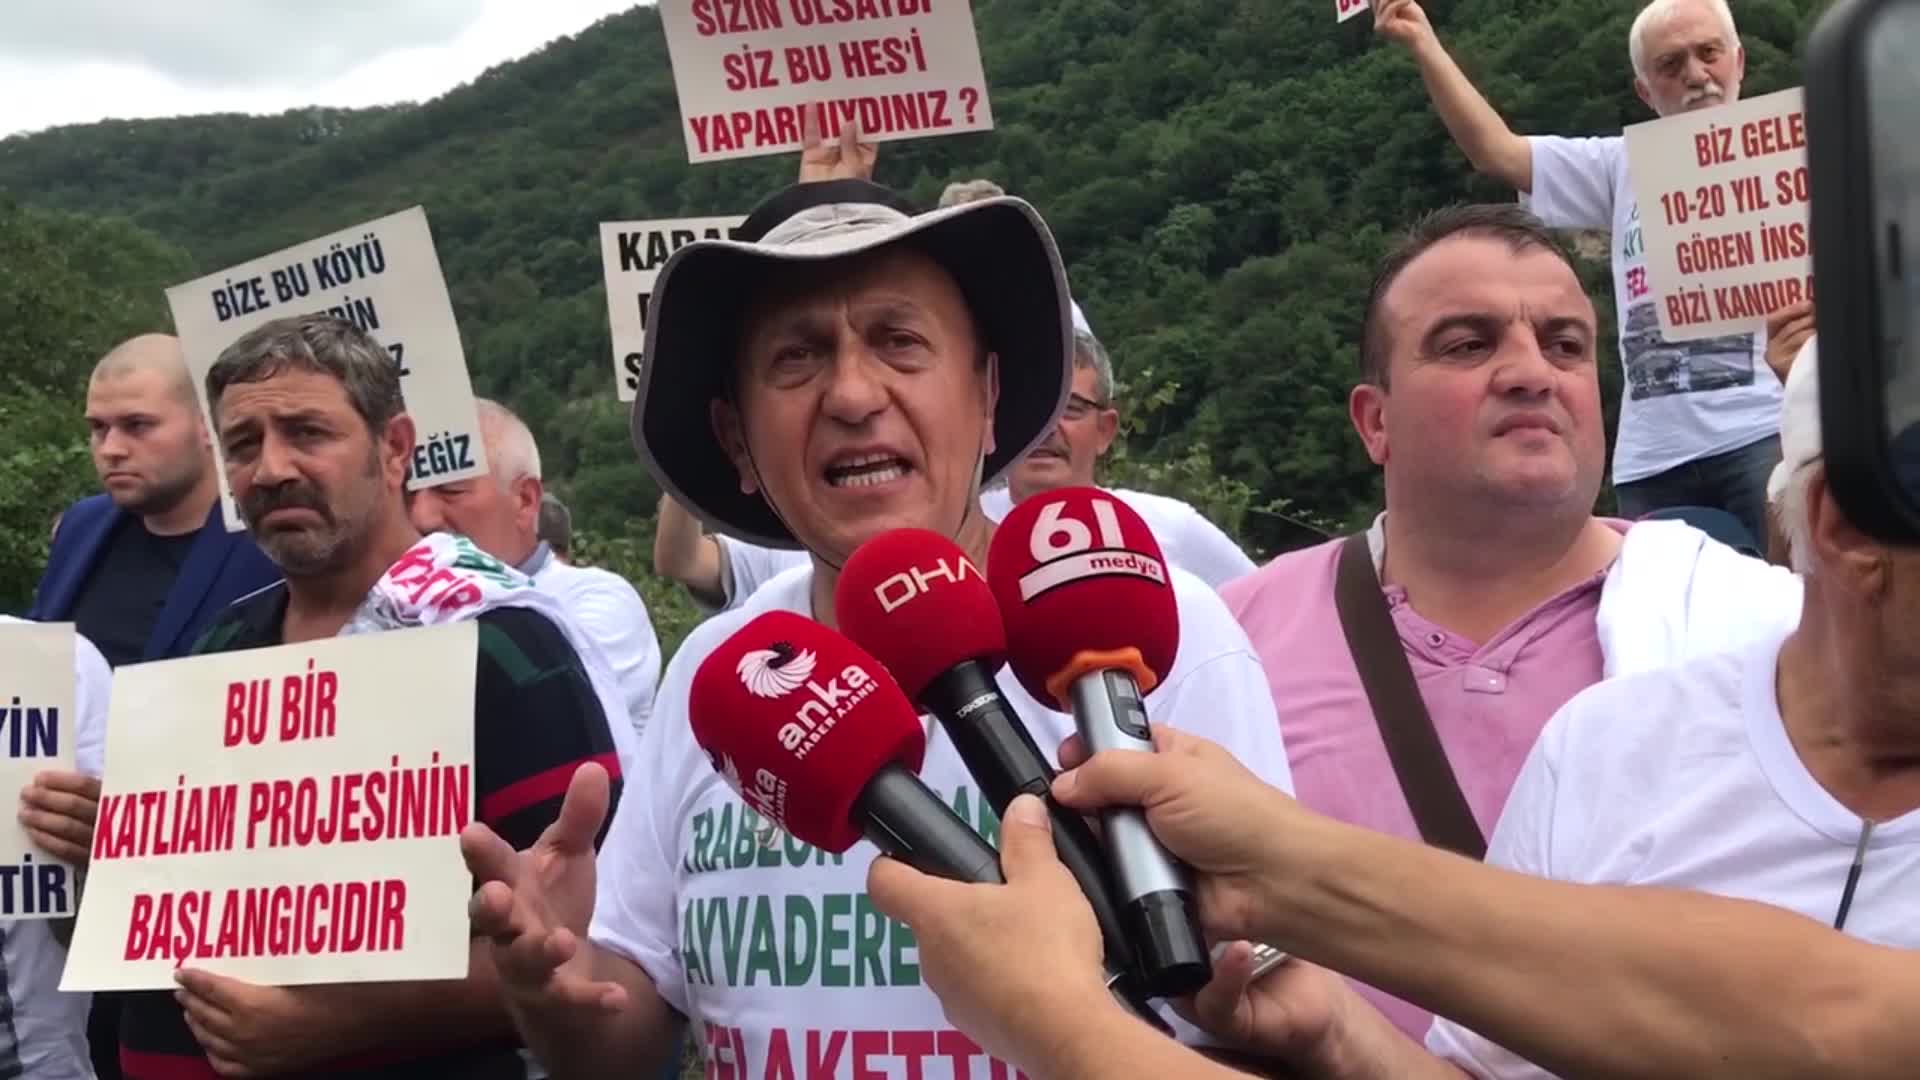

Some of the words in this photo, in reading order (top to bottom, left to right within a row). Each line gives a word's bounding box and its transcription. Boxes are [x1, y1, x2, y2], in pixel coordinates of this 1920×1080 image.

[723, 44, 779, 91] SİZ
[785, 45, 831, 84] BU
[840, 28, 926, 78] HES'İ
[959, 88, 979, 123] ?
[1694, 124, 1736, 167] BİZ
[1741, 113, 1806, 158] GELE
[1660, 184, 1725, 225] 10-20
[1730, 176, 1769, 213] YIL
[212, 279, 270, 321] BİZE
[272, 262, 310, 303] BU
[315, 233, 385, 290] KÖYÜ
[1676, 232, 1754, 275] GÖREN
[1665, 283, 1712, 326] BİZİ
[407, 432, 475, 479] EĞİZ
[1030, 498, 1126, 563] 61
[223, 679, 271, 747] BU
[280, 658, 338, 741] BİR
[777, 664, 870, 750] anka
[795, 718, 837, 760] HABER
[836, 679, 879, 719] AJANSI
[93, 775, 237, 860] KATLİAM
[247, 752, 469, 849] PROJESİNİN
[124, 880, 406, 968] BAŞLANGICIDIR
